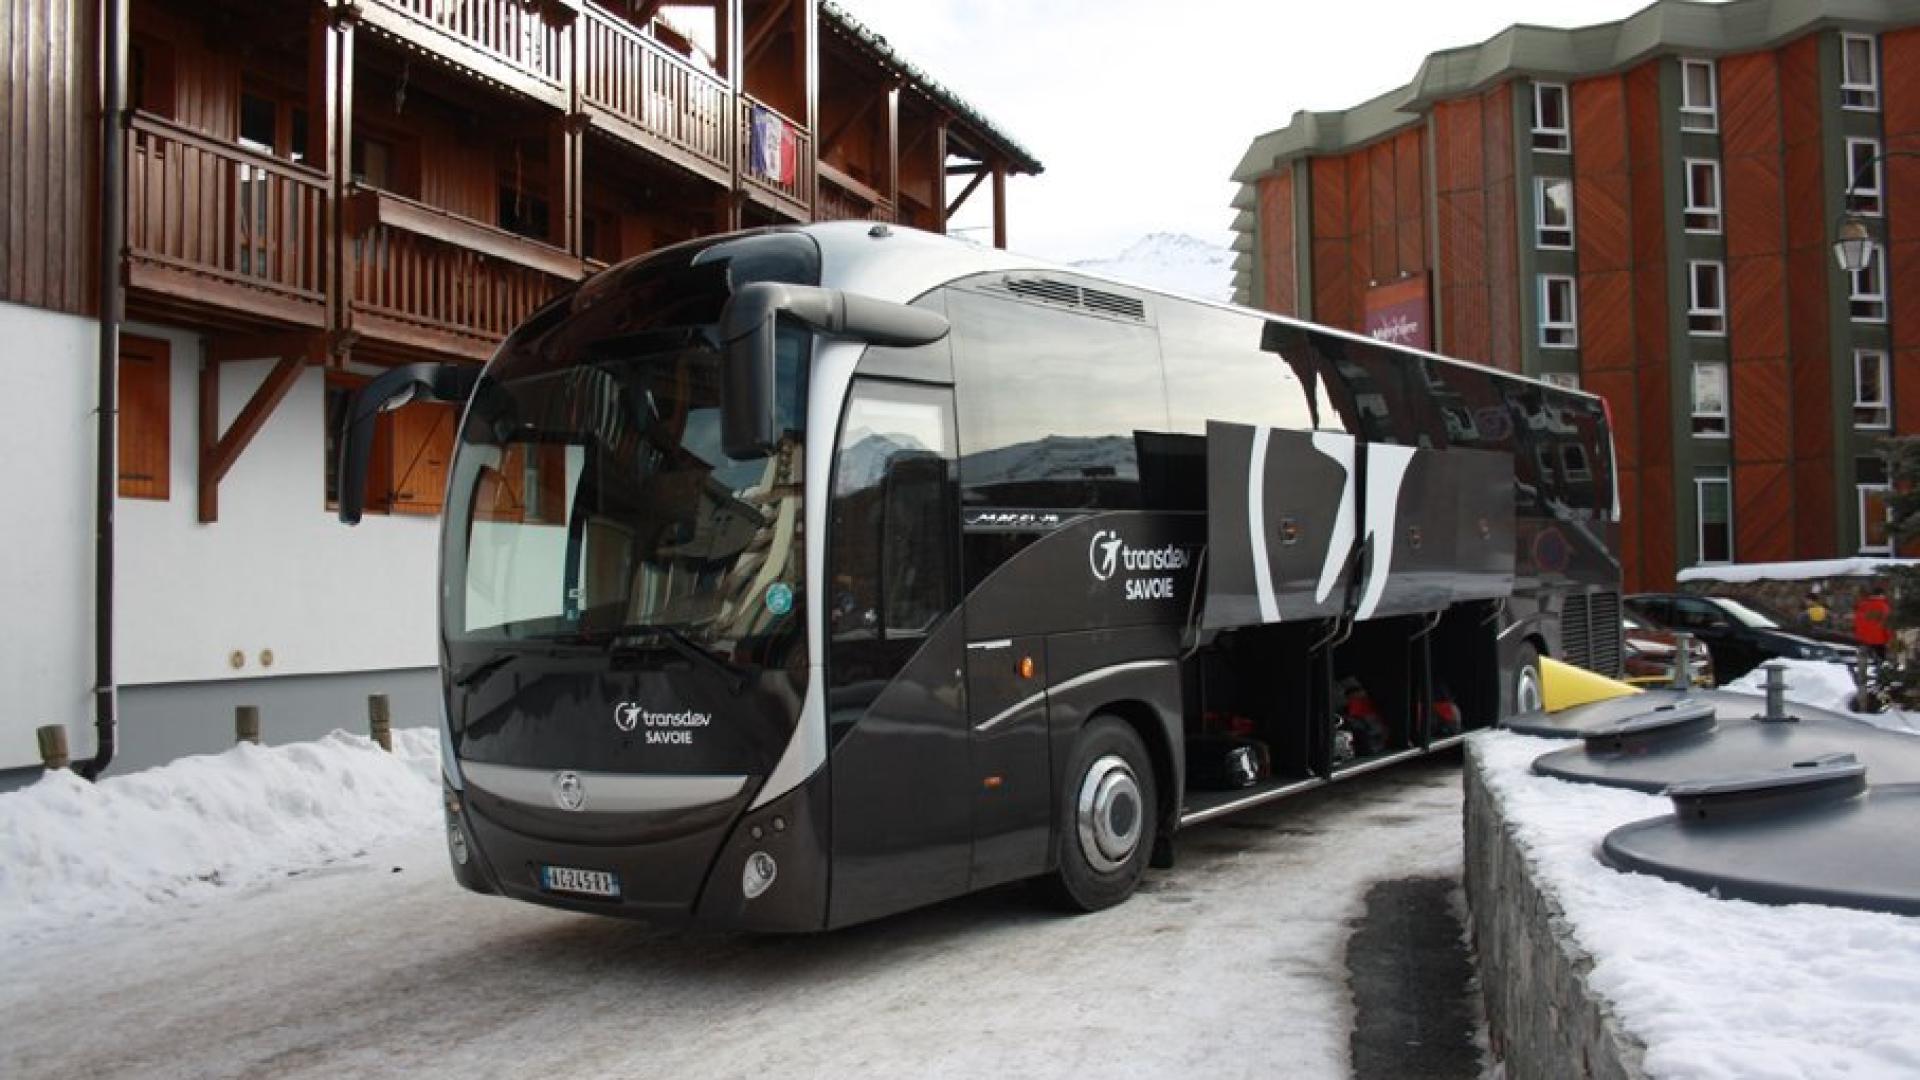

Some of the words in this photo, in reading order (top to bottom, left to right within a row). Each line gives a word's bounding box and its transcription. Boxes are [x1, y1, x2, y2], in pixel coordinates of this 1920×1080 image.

[1122, 544, 1190, 571] transdev
[1125, 578, 1174, 600] SAVOIE
[643, 708, 712, 727] transdev
[645, 730, 693, 744] SAVOIE
